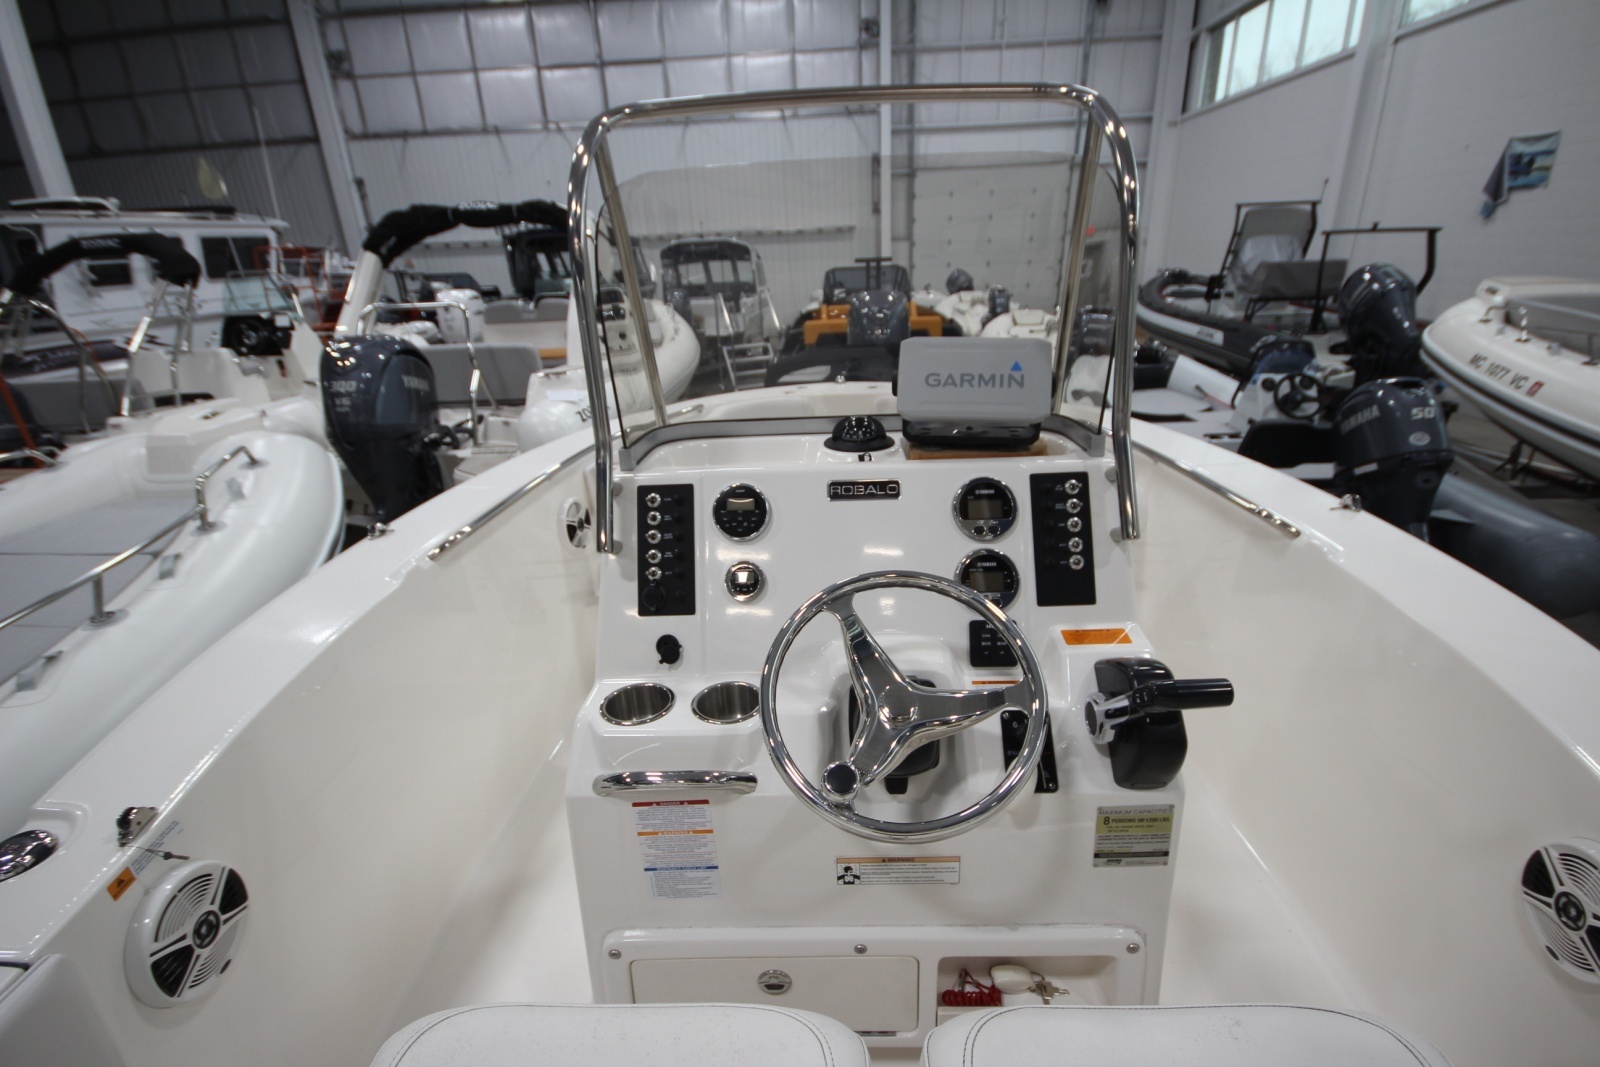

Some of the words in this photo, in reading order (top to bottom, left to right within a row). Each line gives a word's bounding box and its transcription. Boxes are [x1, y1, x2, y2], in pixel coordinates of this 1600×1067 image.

[924, 372, 1025, 389] GARMIN
[1485, 362, 1511, 379] 1077
[1509, 373, 1529, 390] VC
[1340, 404, 1380, 435] YAMAHA
[1411, 407, 1435, 420] 50
[830, 484, 899, 496] ROBALO
[1103, 816, 1110, 825] 8
